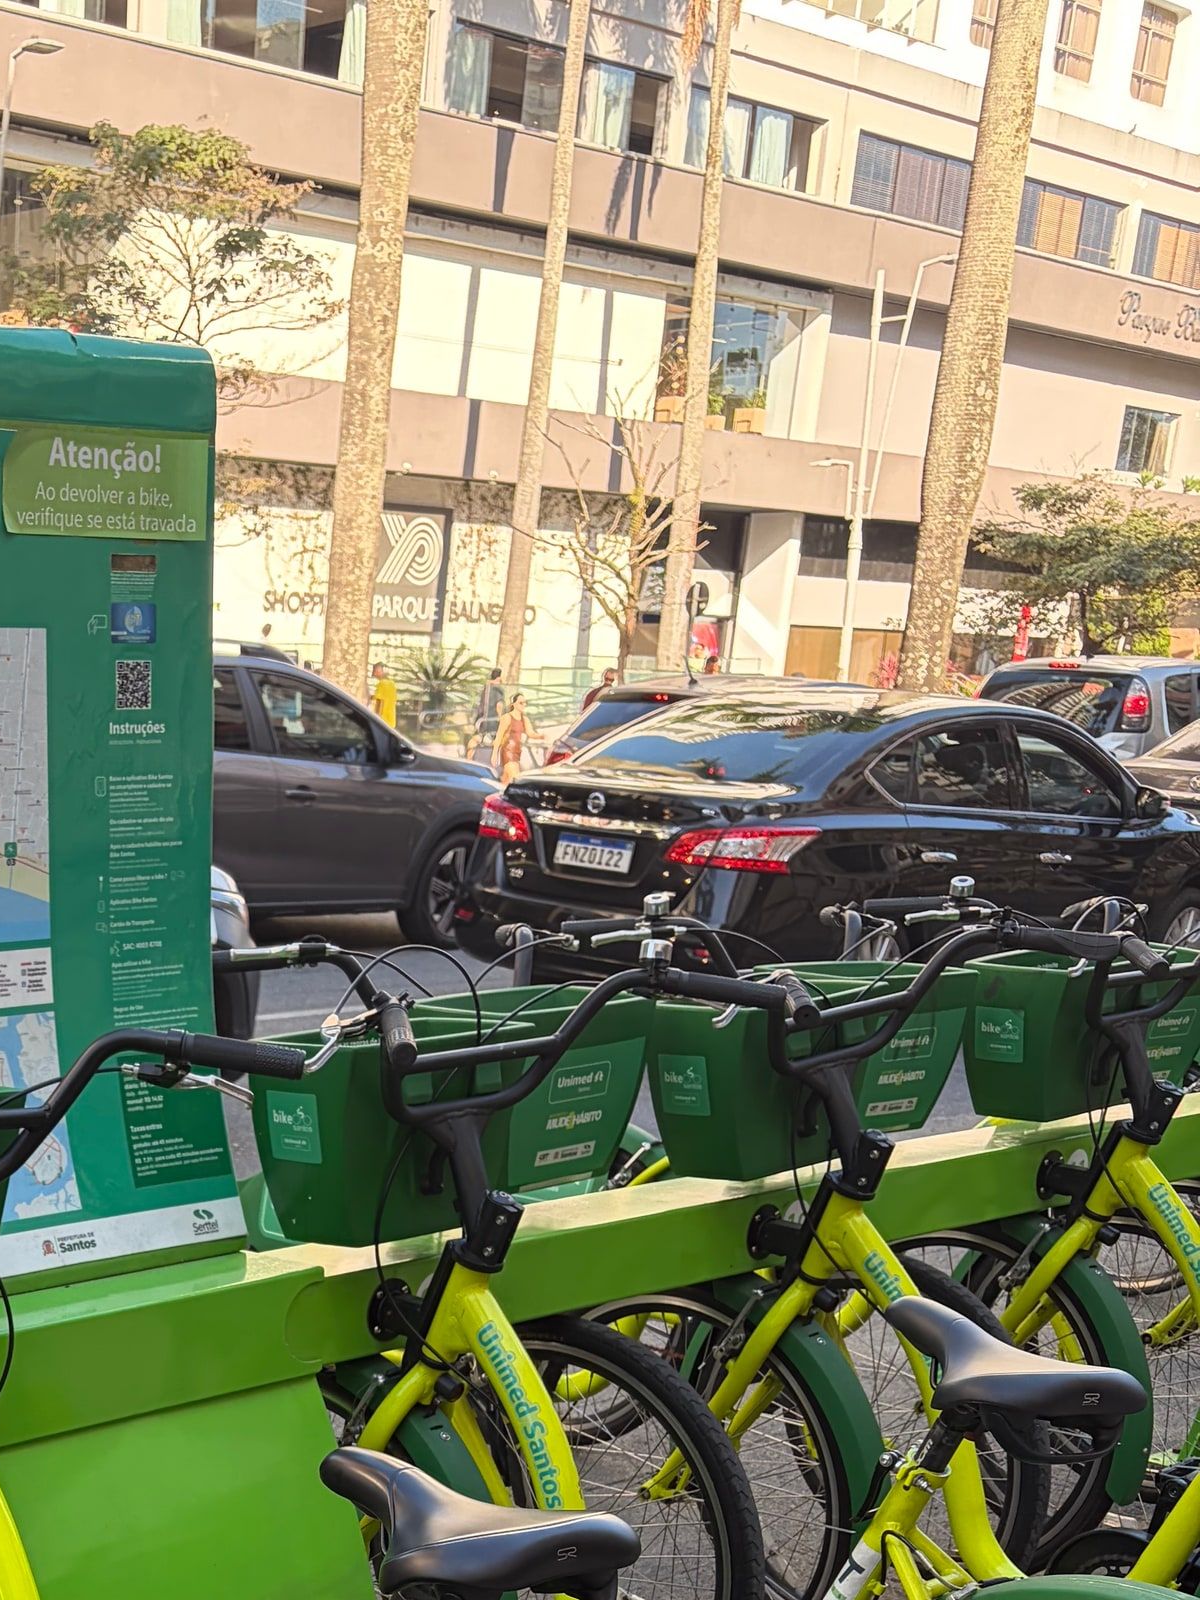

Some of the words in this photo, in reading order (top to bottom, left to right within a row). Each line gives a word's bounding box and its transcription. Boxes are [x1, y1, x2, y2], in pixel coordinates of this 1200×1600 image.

[49, 437, 161, 479] Atenção!
[35, 481, 56, 501] Ao
[60, 482, 124, 504] devolver
[127, 492, 135, 505] a
[140, 487, 173, 510] bike,
[17, 507, 83, 531] verifique
[87, 514, 103, 528] se
[106, 512, 135, 530] está
[140, 514, 197, 533] travada
[264, 590, 326, 617] SHOPPI
[372, 594, 440, 622] PARQUE
[109, 721, 166, 738] Instruções
[981, 1021, 1001, 1034] bike
[557, 1072, 593, 1089] Unimed
[664, 1071, 684, 1084] bike
[272, 1109, 293, 1125] bike
[1148, 1183, 1200, 1257] Unimed
[59, 1239, 97, 1253] Santos
[864, 1251, 905, 1300] Uni
[477, 1322, 540, 1418] Unimed
[523, 1420, 563, 1510] Santos
